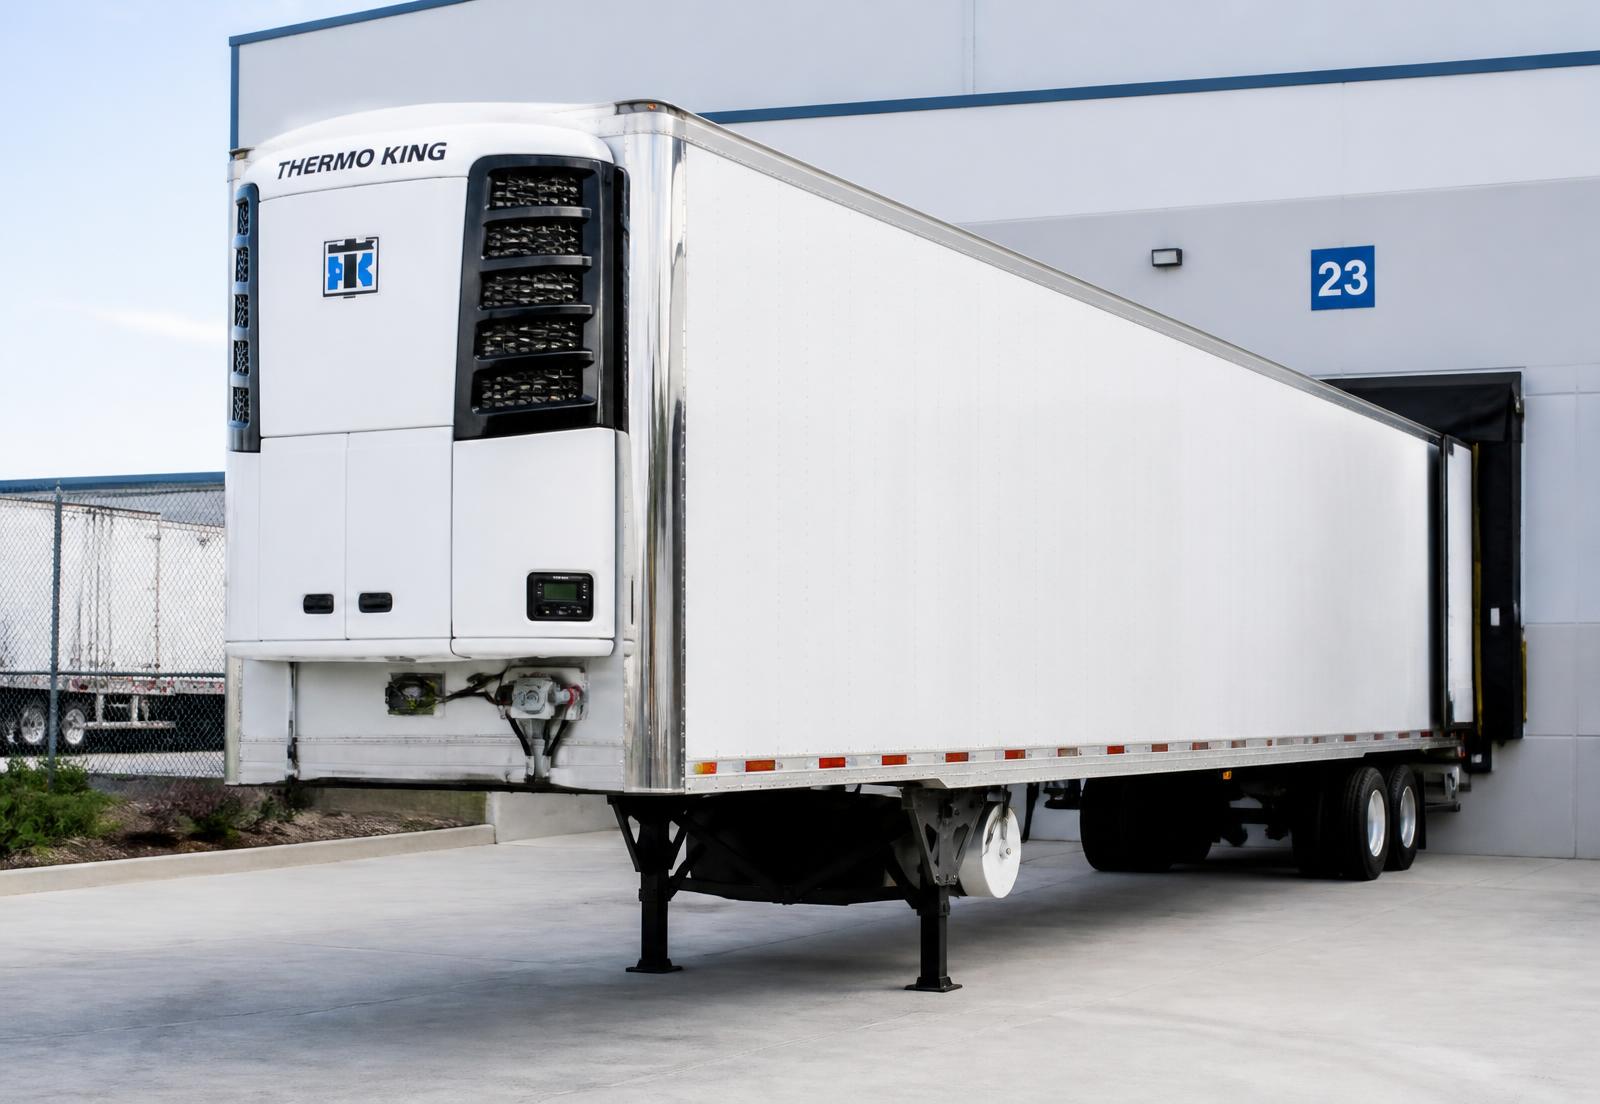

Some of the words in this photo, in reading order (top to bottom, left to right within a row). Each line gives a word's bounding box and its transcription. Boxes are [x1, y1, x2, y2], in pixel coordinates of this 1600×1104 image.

[277, 148, 375, 180] THERMO
[381, 142, 447, 165] KING
[1318, 259, 1368, 296] 23
